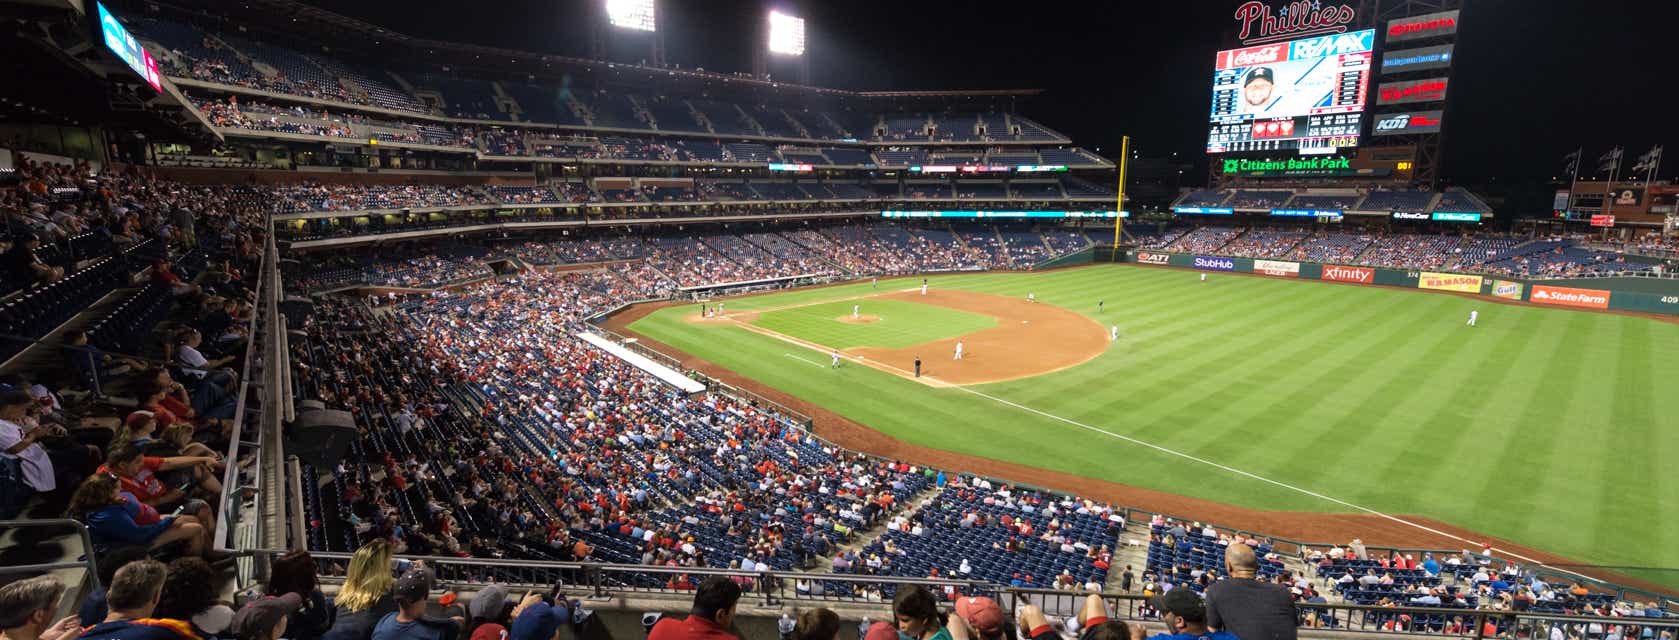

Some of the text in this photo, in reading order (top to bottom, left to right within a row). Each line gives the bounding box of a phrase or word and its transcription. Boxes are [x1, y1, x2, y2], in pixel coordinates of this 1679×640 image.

[1234, 0, 1354, 39] Phillies
[1403, 18, 1456, 33] TOYOTA
[1293, 33, 1369, 60] RE/MAX
[1240, 157, 1350, 171] Citizens Bank Park
[1148, 254, 1169, 262] ATI
[1195, 257, 1234, 269] StubHub
[1325, 266, 1370, 282] xfinity
[1497, 285, 1517, 294] Gulf
[1550, 291, 1606, 304] State Farm
[1660, 295, 1679, 304] 409
